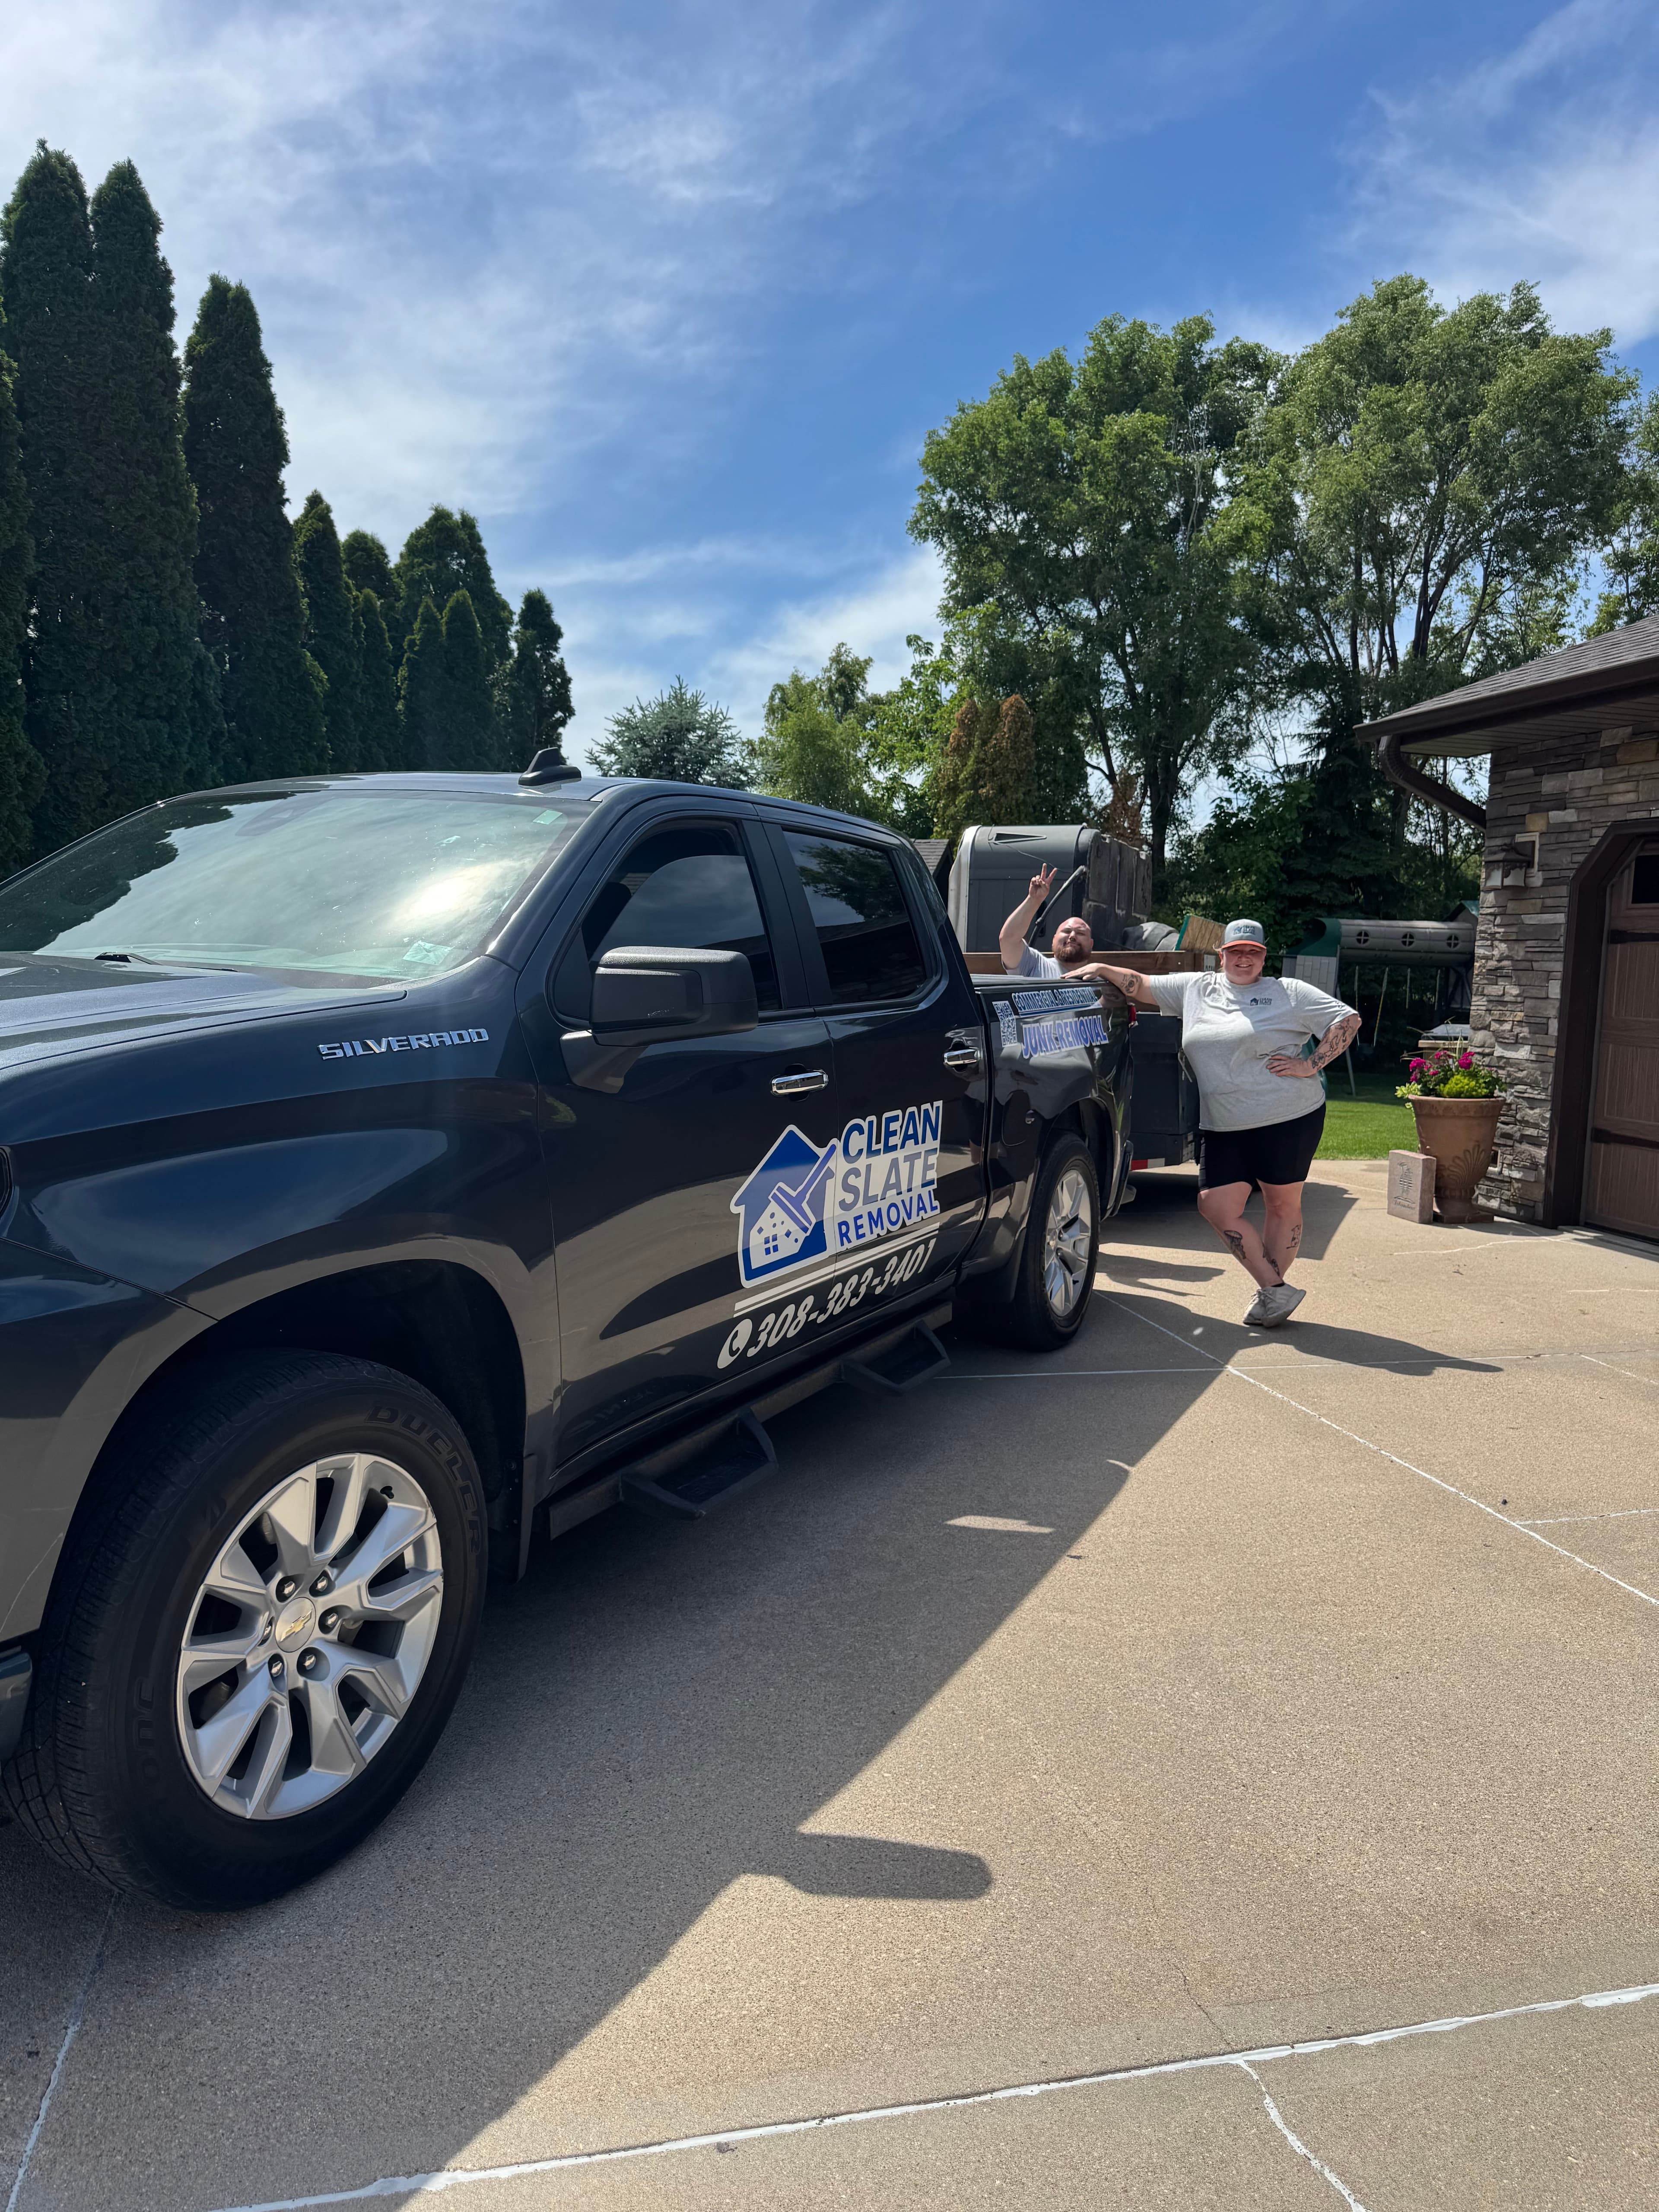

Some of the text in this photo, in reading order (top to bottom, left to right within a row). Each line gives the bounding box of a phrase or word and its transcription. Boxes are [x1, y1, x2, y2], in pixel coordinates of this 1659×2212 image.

[1012, 990, 1058, 1011] COMMERCIAL
[1058, 987, 1098, 1006] RESIDENTIAL
[318, 1028, 489, 1060] SILVERADO
[1022, 1015, 1107, 1057] JUNK REMOVAL
[842, 1104, 941, 1164] CLEAN
[838, 1147, 938, 1212] SLATE
[837, 1189, 939, 1247] REMOVAL
[746, 1237, 937, 1358] 308-383-3401
[364, 1405, 482, 1555] DUELER
